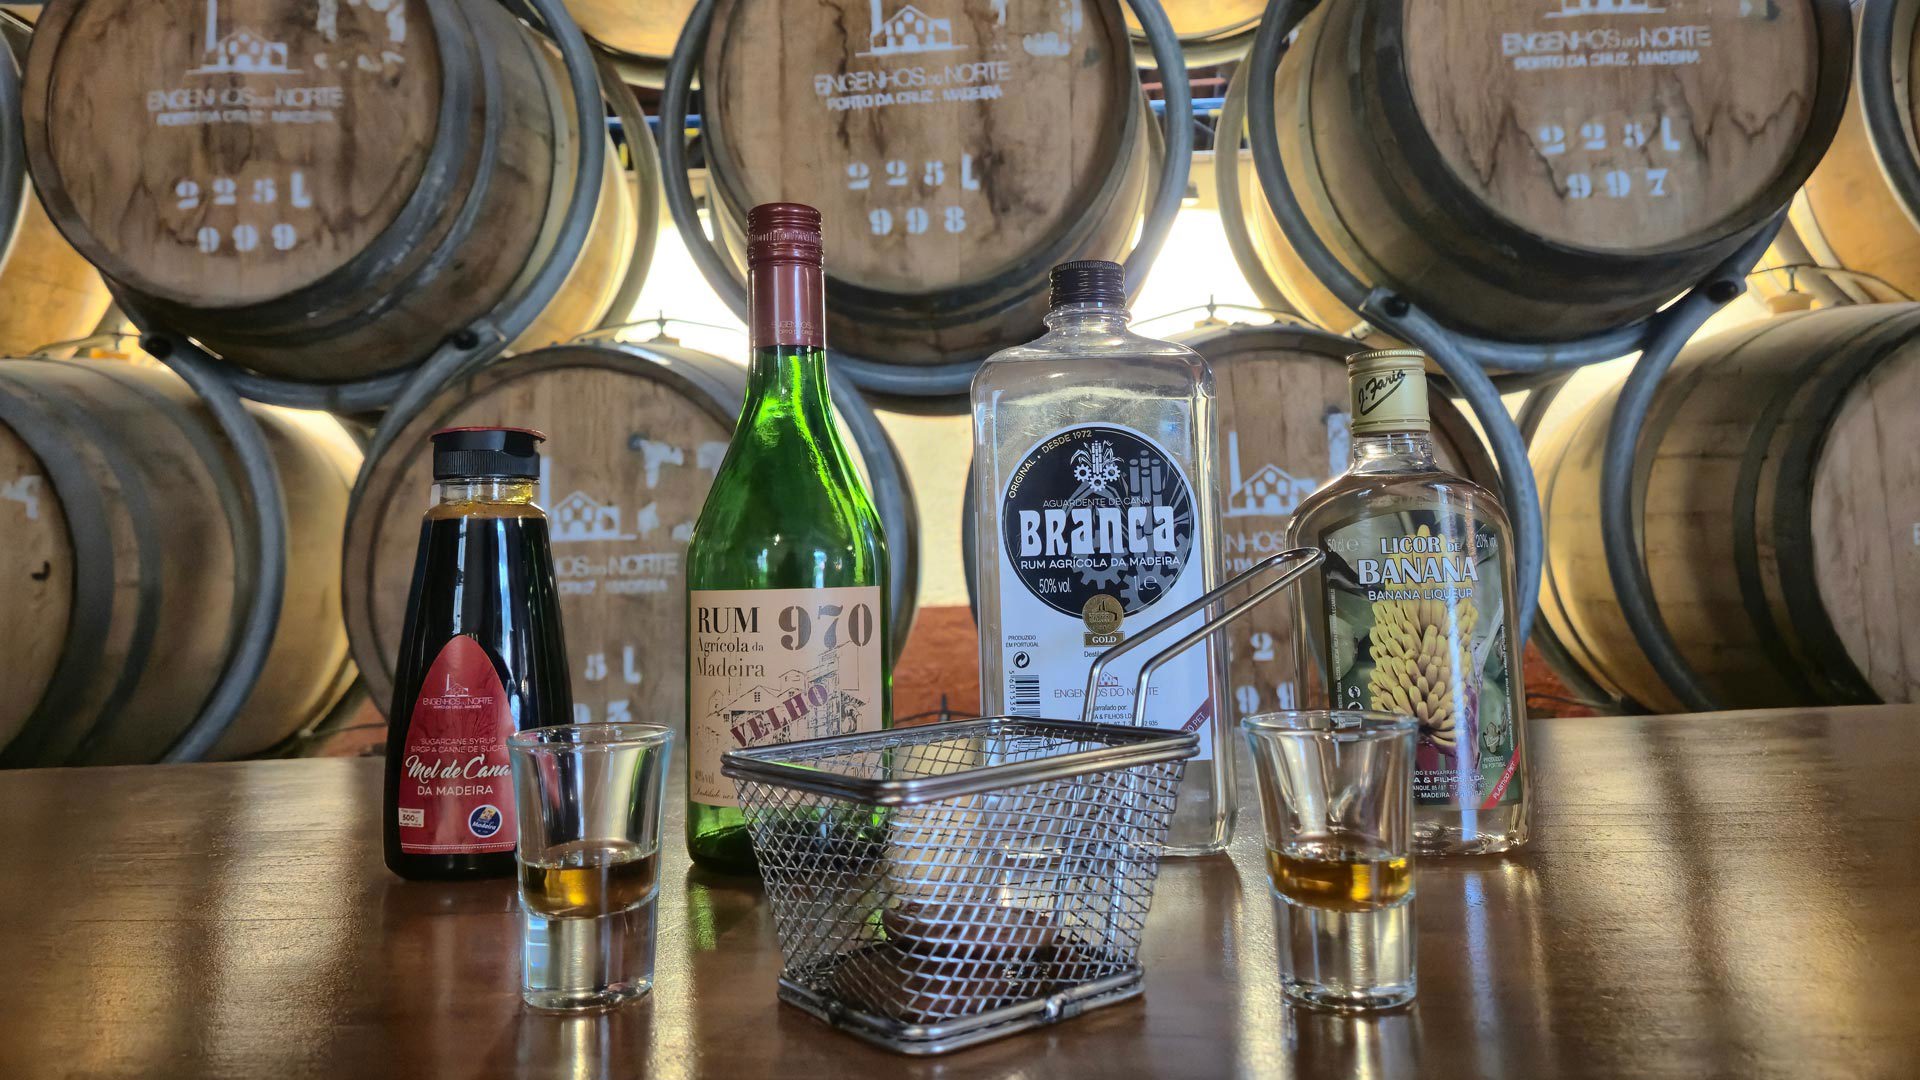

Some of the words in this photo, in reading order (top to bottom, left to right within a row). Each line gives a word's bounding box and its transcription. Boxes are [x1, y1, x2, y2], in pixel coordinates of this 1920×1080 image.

[1640, 24, 1713, 48] NORTE
[815, 66, 926, 97] ENGENHOS
[944, 60, 1011, 83] NORTE
[1008, 458, 1036, 499] ORIGINAL
[1041, 433, 1072, 454] DESDE
[1072, 429, 1093, 440] 1972
[1043, 498, 1106, 508] AGUARDENTE
[1108, 497, 1121, 506] DE
[1123, 496, 1151, 506] CANA
[1380, 536, 1442, 555] LICOR
[1447, 541, 1461, 553] DE
[1020, 560, 1046, 570] RUM
[1049, 556, 1108, 569] AGRÍCOLA
[1111, 558, 1127, 568] DA
[1129, 556, 1181, 567] MADEIRA
[1356, 556, 1480, 586] BANANA
[1039, 579, 1057, 594] 50%
[1058, 576, 1072, 594] vol.
[1368, 590, 1421, 601] BANANA
[1424, 588, 1473, 600] LIQUEUR
[698, 606, 761, 634] RUM
[778, 602, 873, 651] 970
[751, 640, 764, 652] da
[1092, 636, 1117, 644] GOLD
[697, 658, 765, 677] Madeira
[1054, 688, 1107, 698] ENGENOS
[1109, 687, 1125, 697] DO
[729, 684, 828, 748] VELHO
[420, 737, 468, 746] SUGARCANE
[469, 736, 497, 745] SYRUP
[438, 745, 467, 753] CANNE
[468, 745, 479, 753] DE
[405, 754, 441, 784] Mel
[440, 759, 464, 779] de
[463, 753, 512, 780] Cana
[1423, 776, 1431, 784] &
[417, 785, 433, 796] DA
[436, 785, 494, 796] MADEIRA
[1420, 791, 1450, 799] MADEIRA
[472, 820, 498, 831] Madeira
